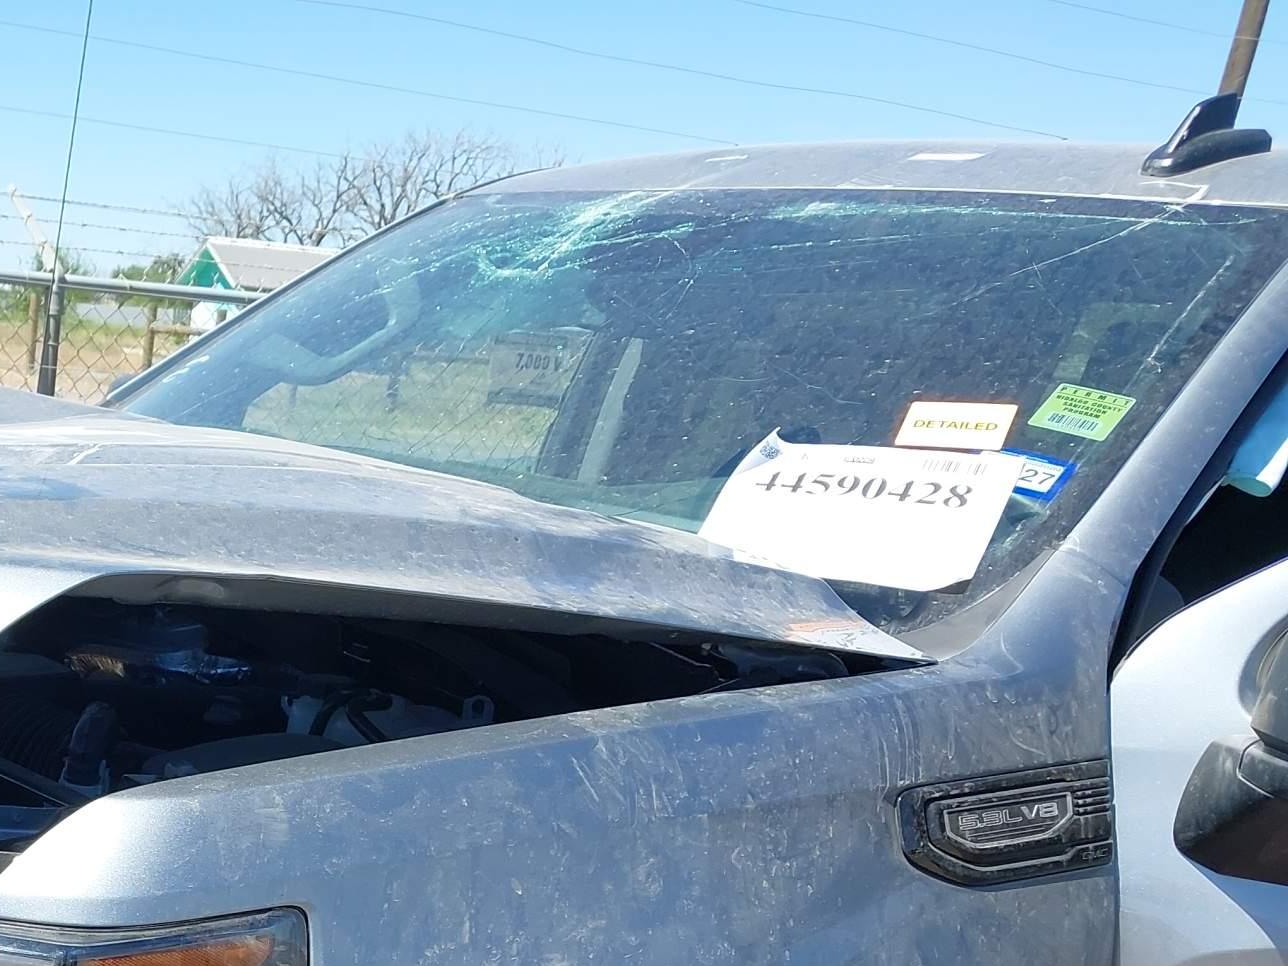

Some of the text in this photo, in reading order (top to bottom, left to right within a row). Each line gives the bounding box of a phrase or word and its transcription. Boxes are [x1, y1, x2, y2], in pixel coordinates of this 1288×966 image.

[1056, 394, 1123, 413] HIDALGO COUNTY
[1060, 386, 1130, 406] PERMIT
[1062, 401, 1108, 415] SANITATION
[1062, 406, 1101, 419] PROGRAM
[912, 419, 999, 431] DETAILED
[1017, 468, 1056, 485] 27
[755, 470, 974, 510] 44590428
[958, 802, 1059, 832] 5.3L V8
